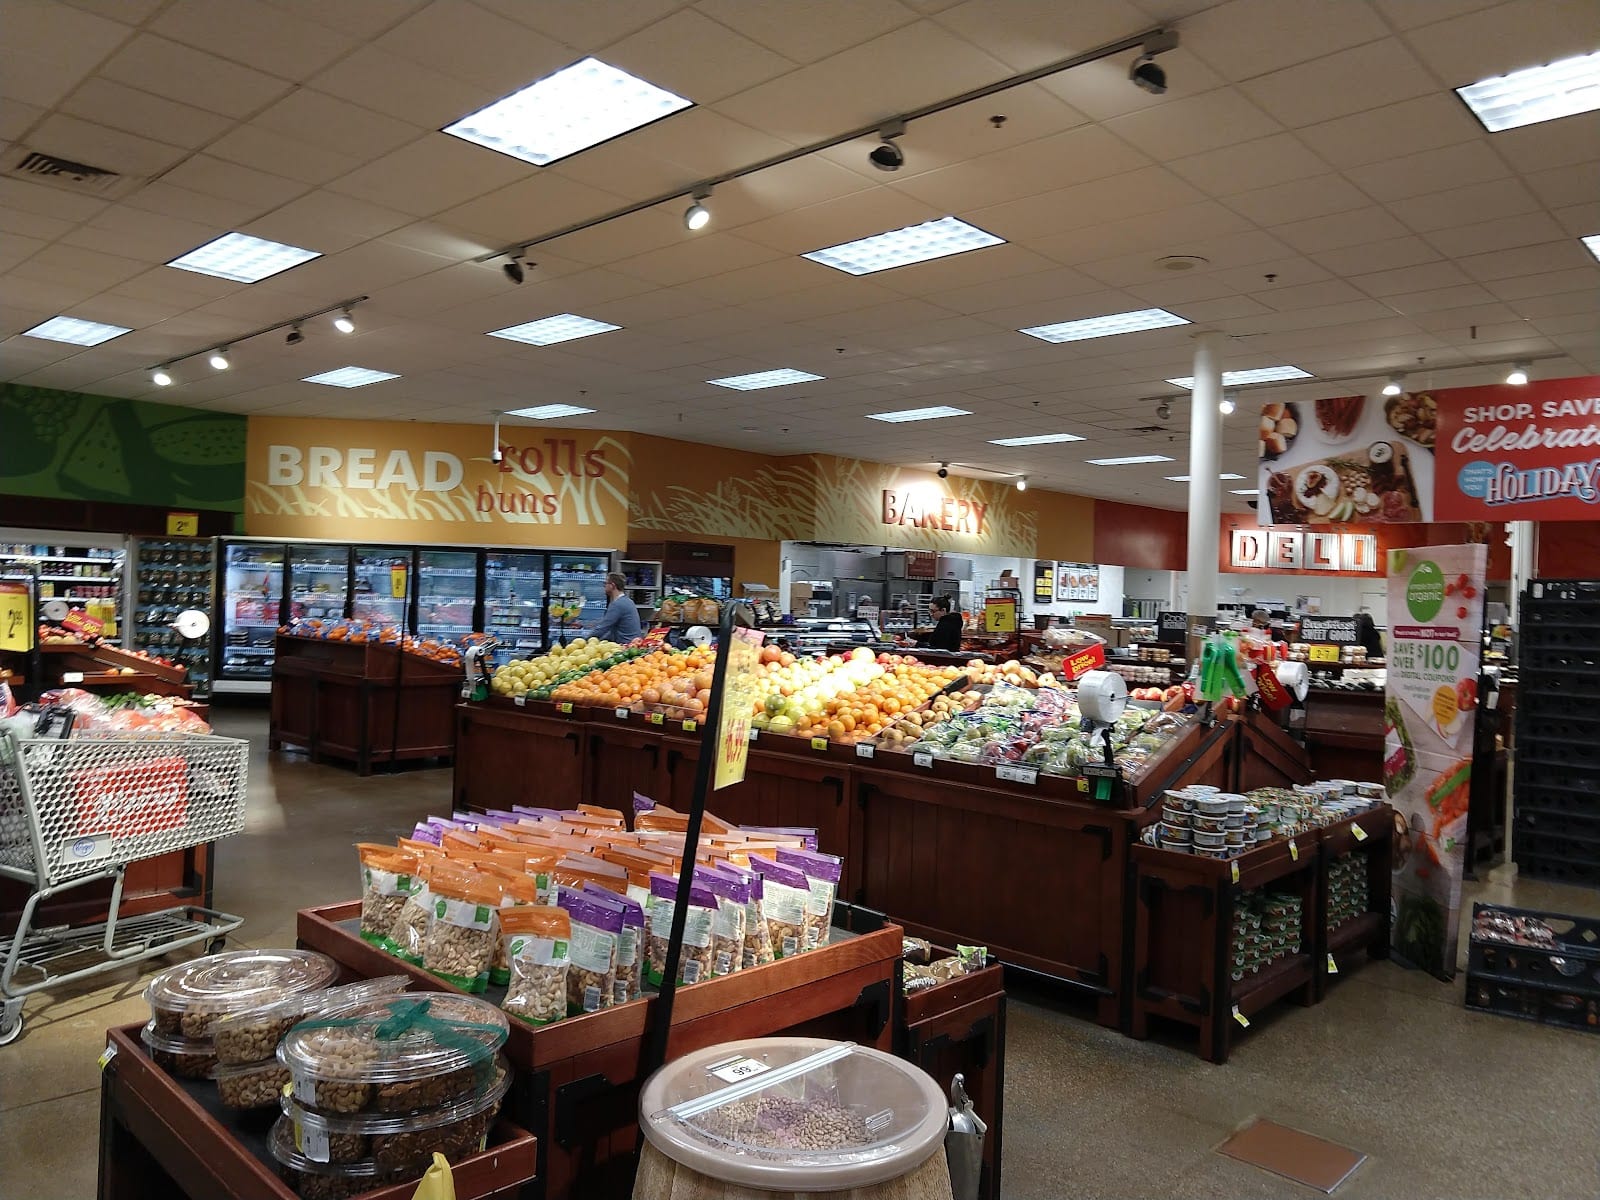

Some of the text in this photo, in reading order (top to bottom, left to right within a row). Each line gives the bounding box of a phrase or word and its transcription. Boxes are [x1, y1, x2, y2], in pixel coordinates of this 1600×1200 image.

[1463, 403, 1536, 423] SHOP.
[1450, 423, 1600, 454] Celebrat
[267, 444, 465, 492] BREAD
[498, 438, 606, 478] rolls
[1484, 460, 1600, 505] HOLIDAY
[476, 485, 558, 516] buns
[881, 489, 988, 535] BAKERY
[1237, 534, 1366, 568] DELI
[1393, 642, 1414, 655] SAVE
[1393, 643, 1459, 671] OVER $100
